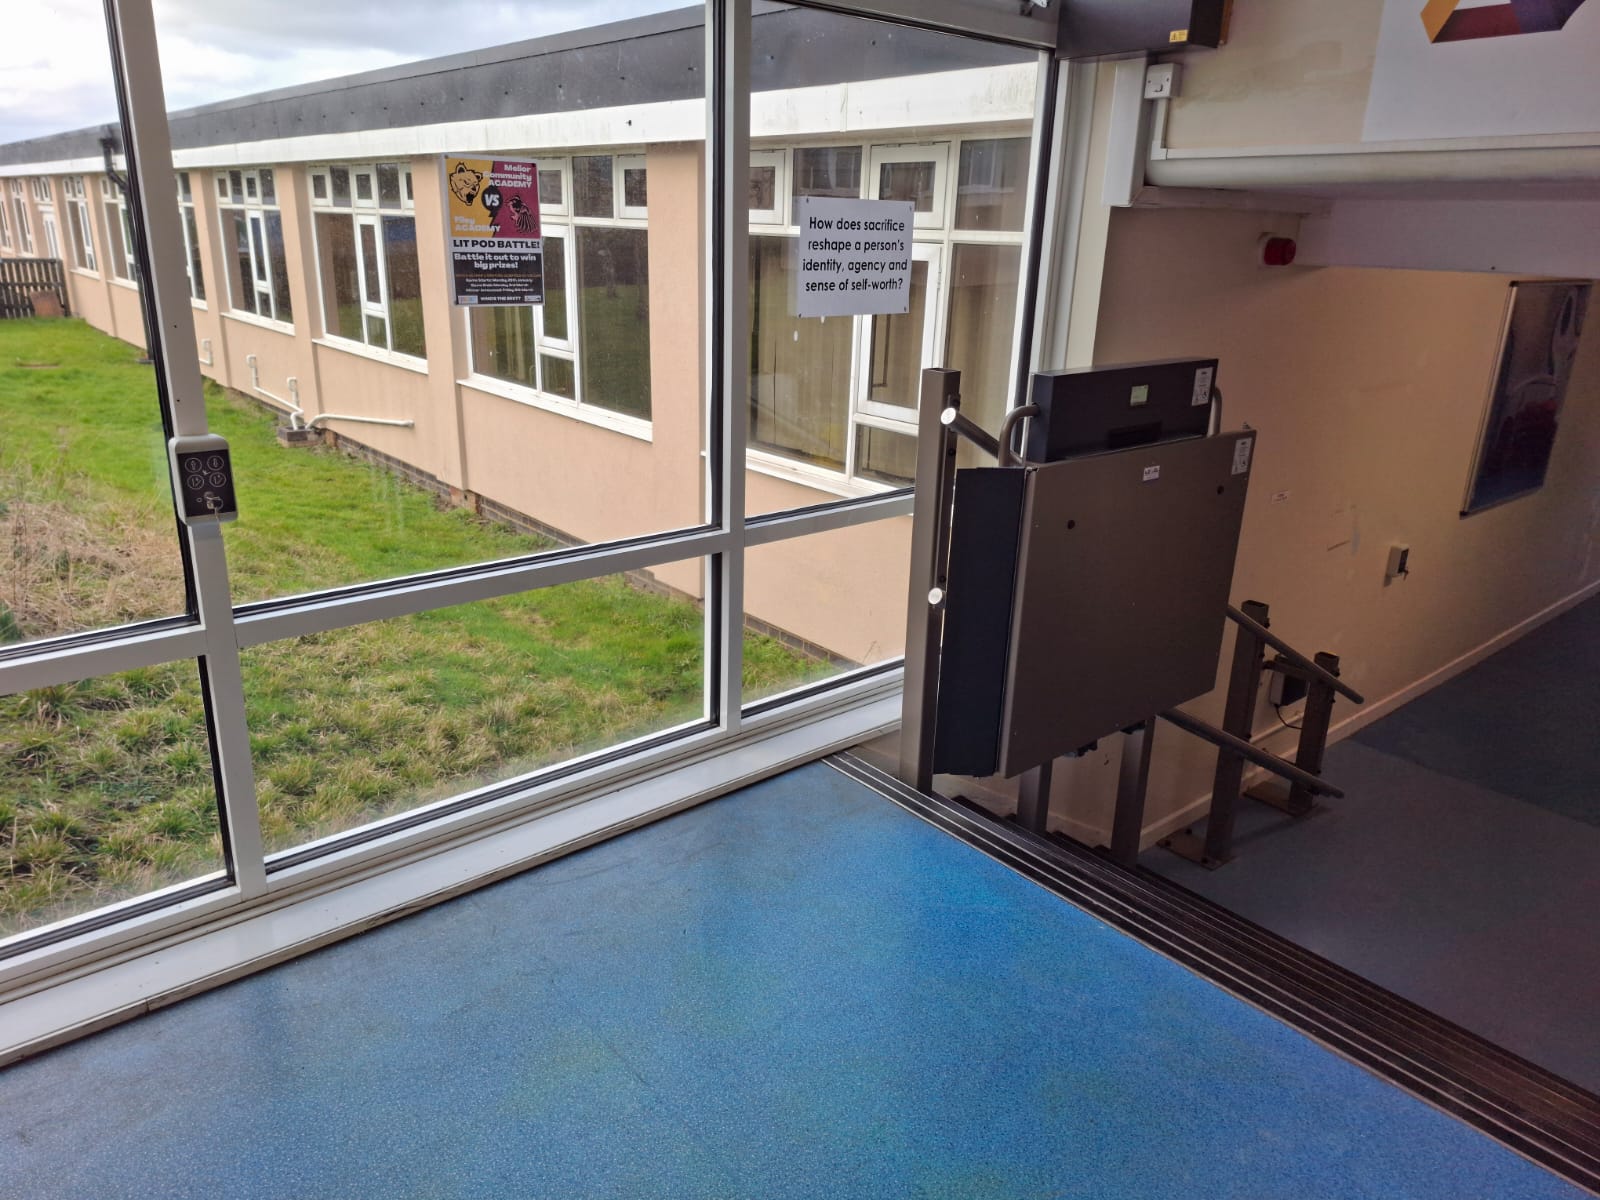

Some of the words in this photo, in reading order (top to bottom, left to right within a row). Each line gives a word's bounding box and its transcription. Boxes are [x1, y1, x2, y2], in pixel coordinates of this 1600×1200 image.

[483, 171, 532, 181] Community
[489, 179, 532, 188] ACADEMY
[484, 194, 500, 207] VS
[455, 224, 501, 233] ACADEMY
[809, 217, 833, 230] How
[837, 218, 861, 231] does
[864, 219, 905, 232] sacrifice
[453, 239, 469, 248] LIT
[471, 240, 495, 248] POD
[497, 240, 540, 249] BATTLE!
[808, 238, 852, 253] reshape
[855, 241, 861, 251] a
[864, 240, 905, 253] person's
[454, 253, 484, 261] Battle
[485, 253, 493, 261] it
[474, 261, 488, 270] big
[489, 261, 518, 270] prizes!
[802, 259, 845, 273] identity,
[848, 261, 886, 274] agency
[889, 259, 908, 271] and
[805, 281, 836, 292] sense
[838, 279, 849, 291] of
[851, 278, 903, 291] self-worth?
